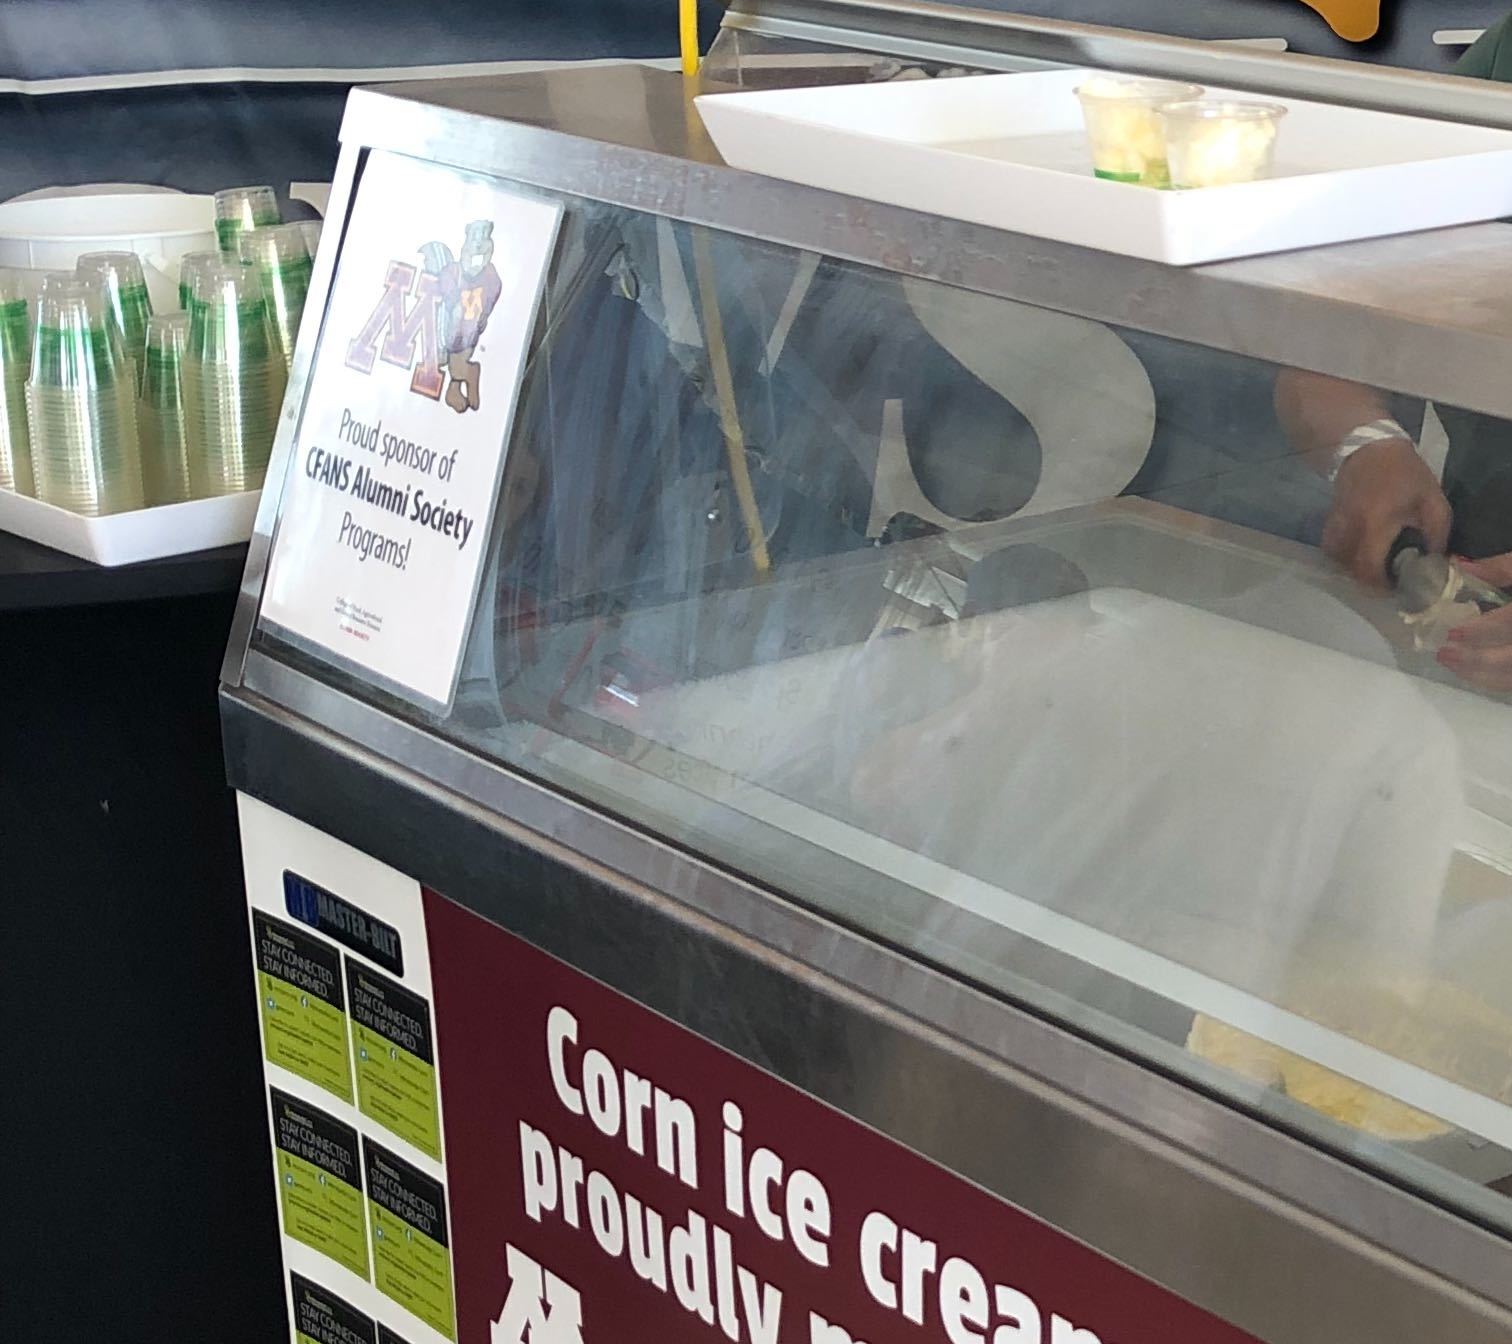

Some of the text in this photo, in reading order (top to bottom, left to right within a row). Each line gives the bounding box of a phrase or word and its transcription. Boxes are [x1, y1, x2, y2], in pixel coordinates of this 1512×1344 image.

[339, 408, 458, 482] Proud sponsor of
[306, 446, 474, 550] CFANS Alumni Society
[339, 511, 412, 571] Programs!
[546, 1006, 698, 1189] Corn
[722, 1101, 832, 1268] ice
